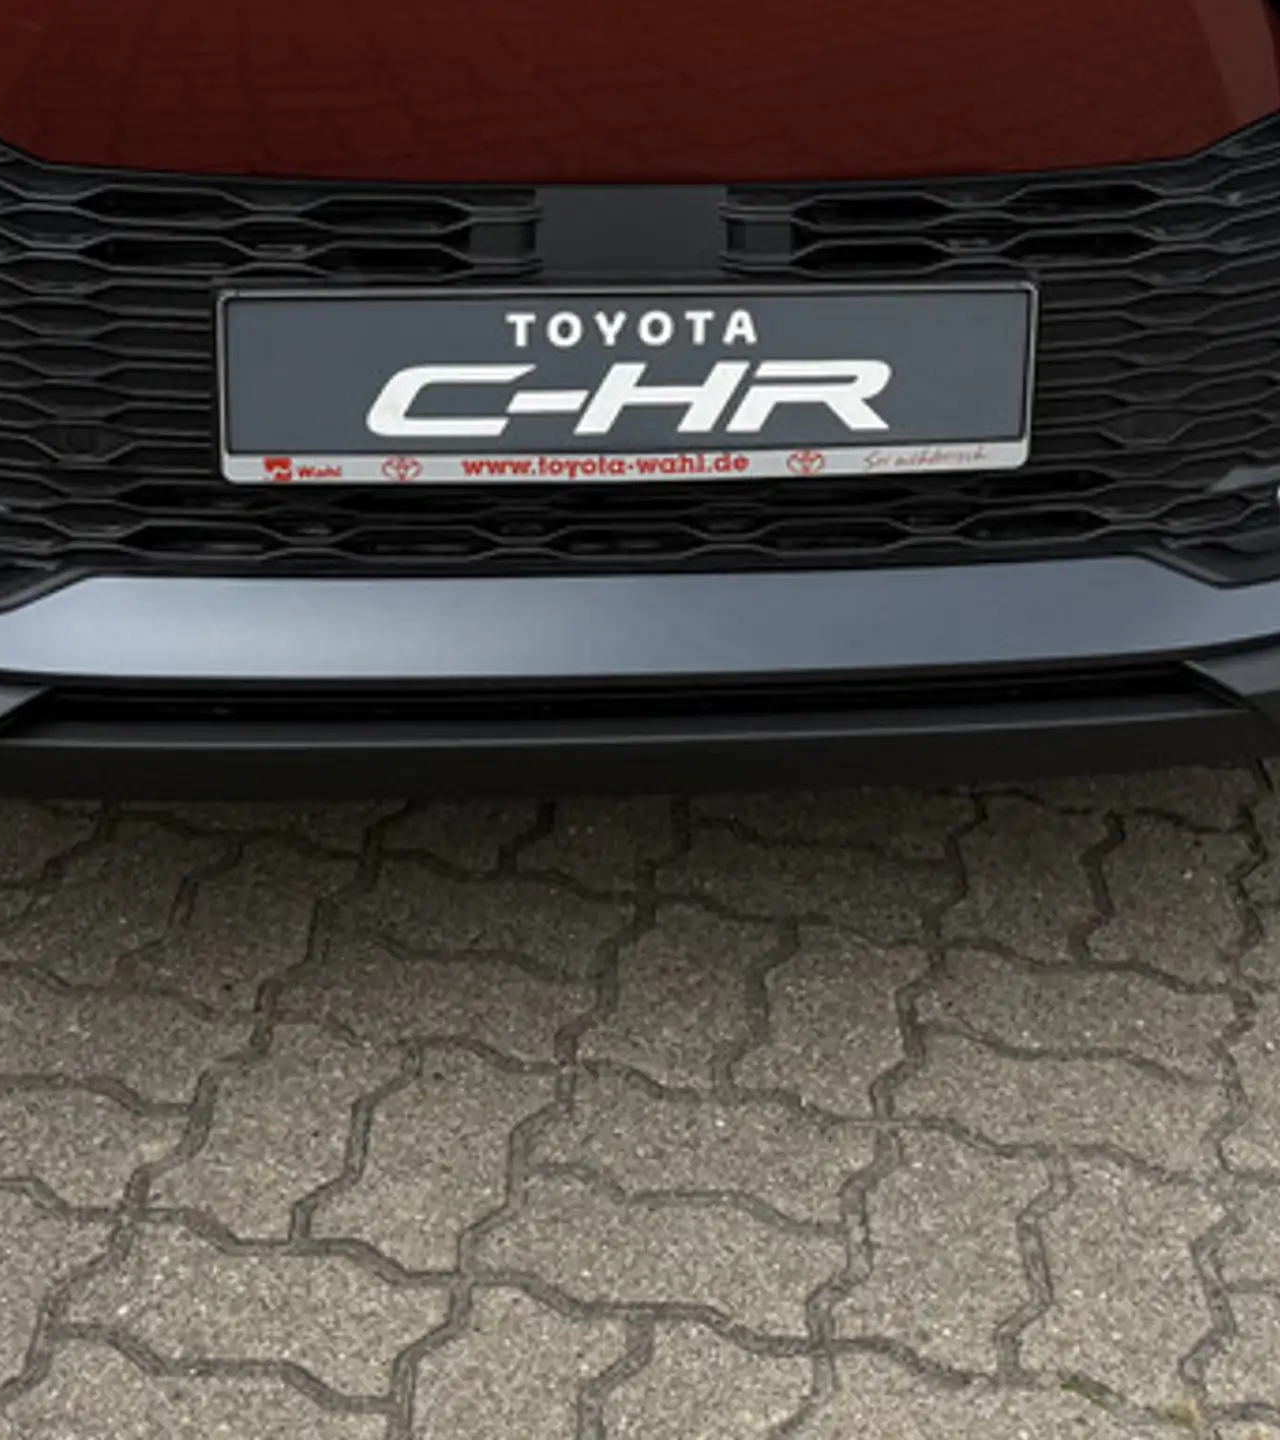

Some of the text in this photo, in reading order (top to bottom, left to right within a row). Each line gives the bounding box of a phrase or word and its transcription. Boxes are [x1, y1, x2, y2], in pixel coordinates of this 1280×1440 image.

[505, 309, 758, 347] TOYOTA
[366, 359, 892, 438] C-HR
[298, 465, 342, 479] Wahl
[461, 453, 750, 479] www.toyota-wahl.de
